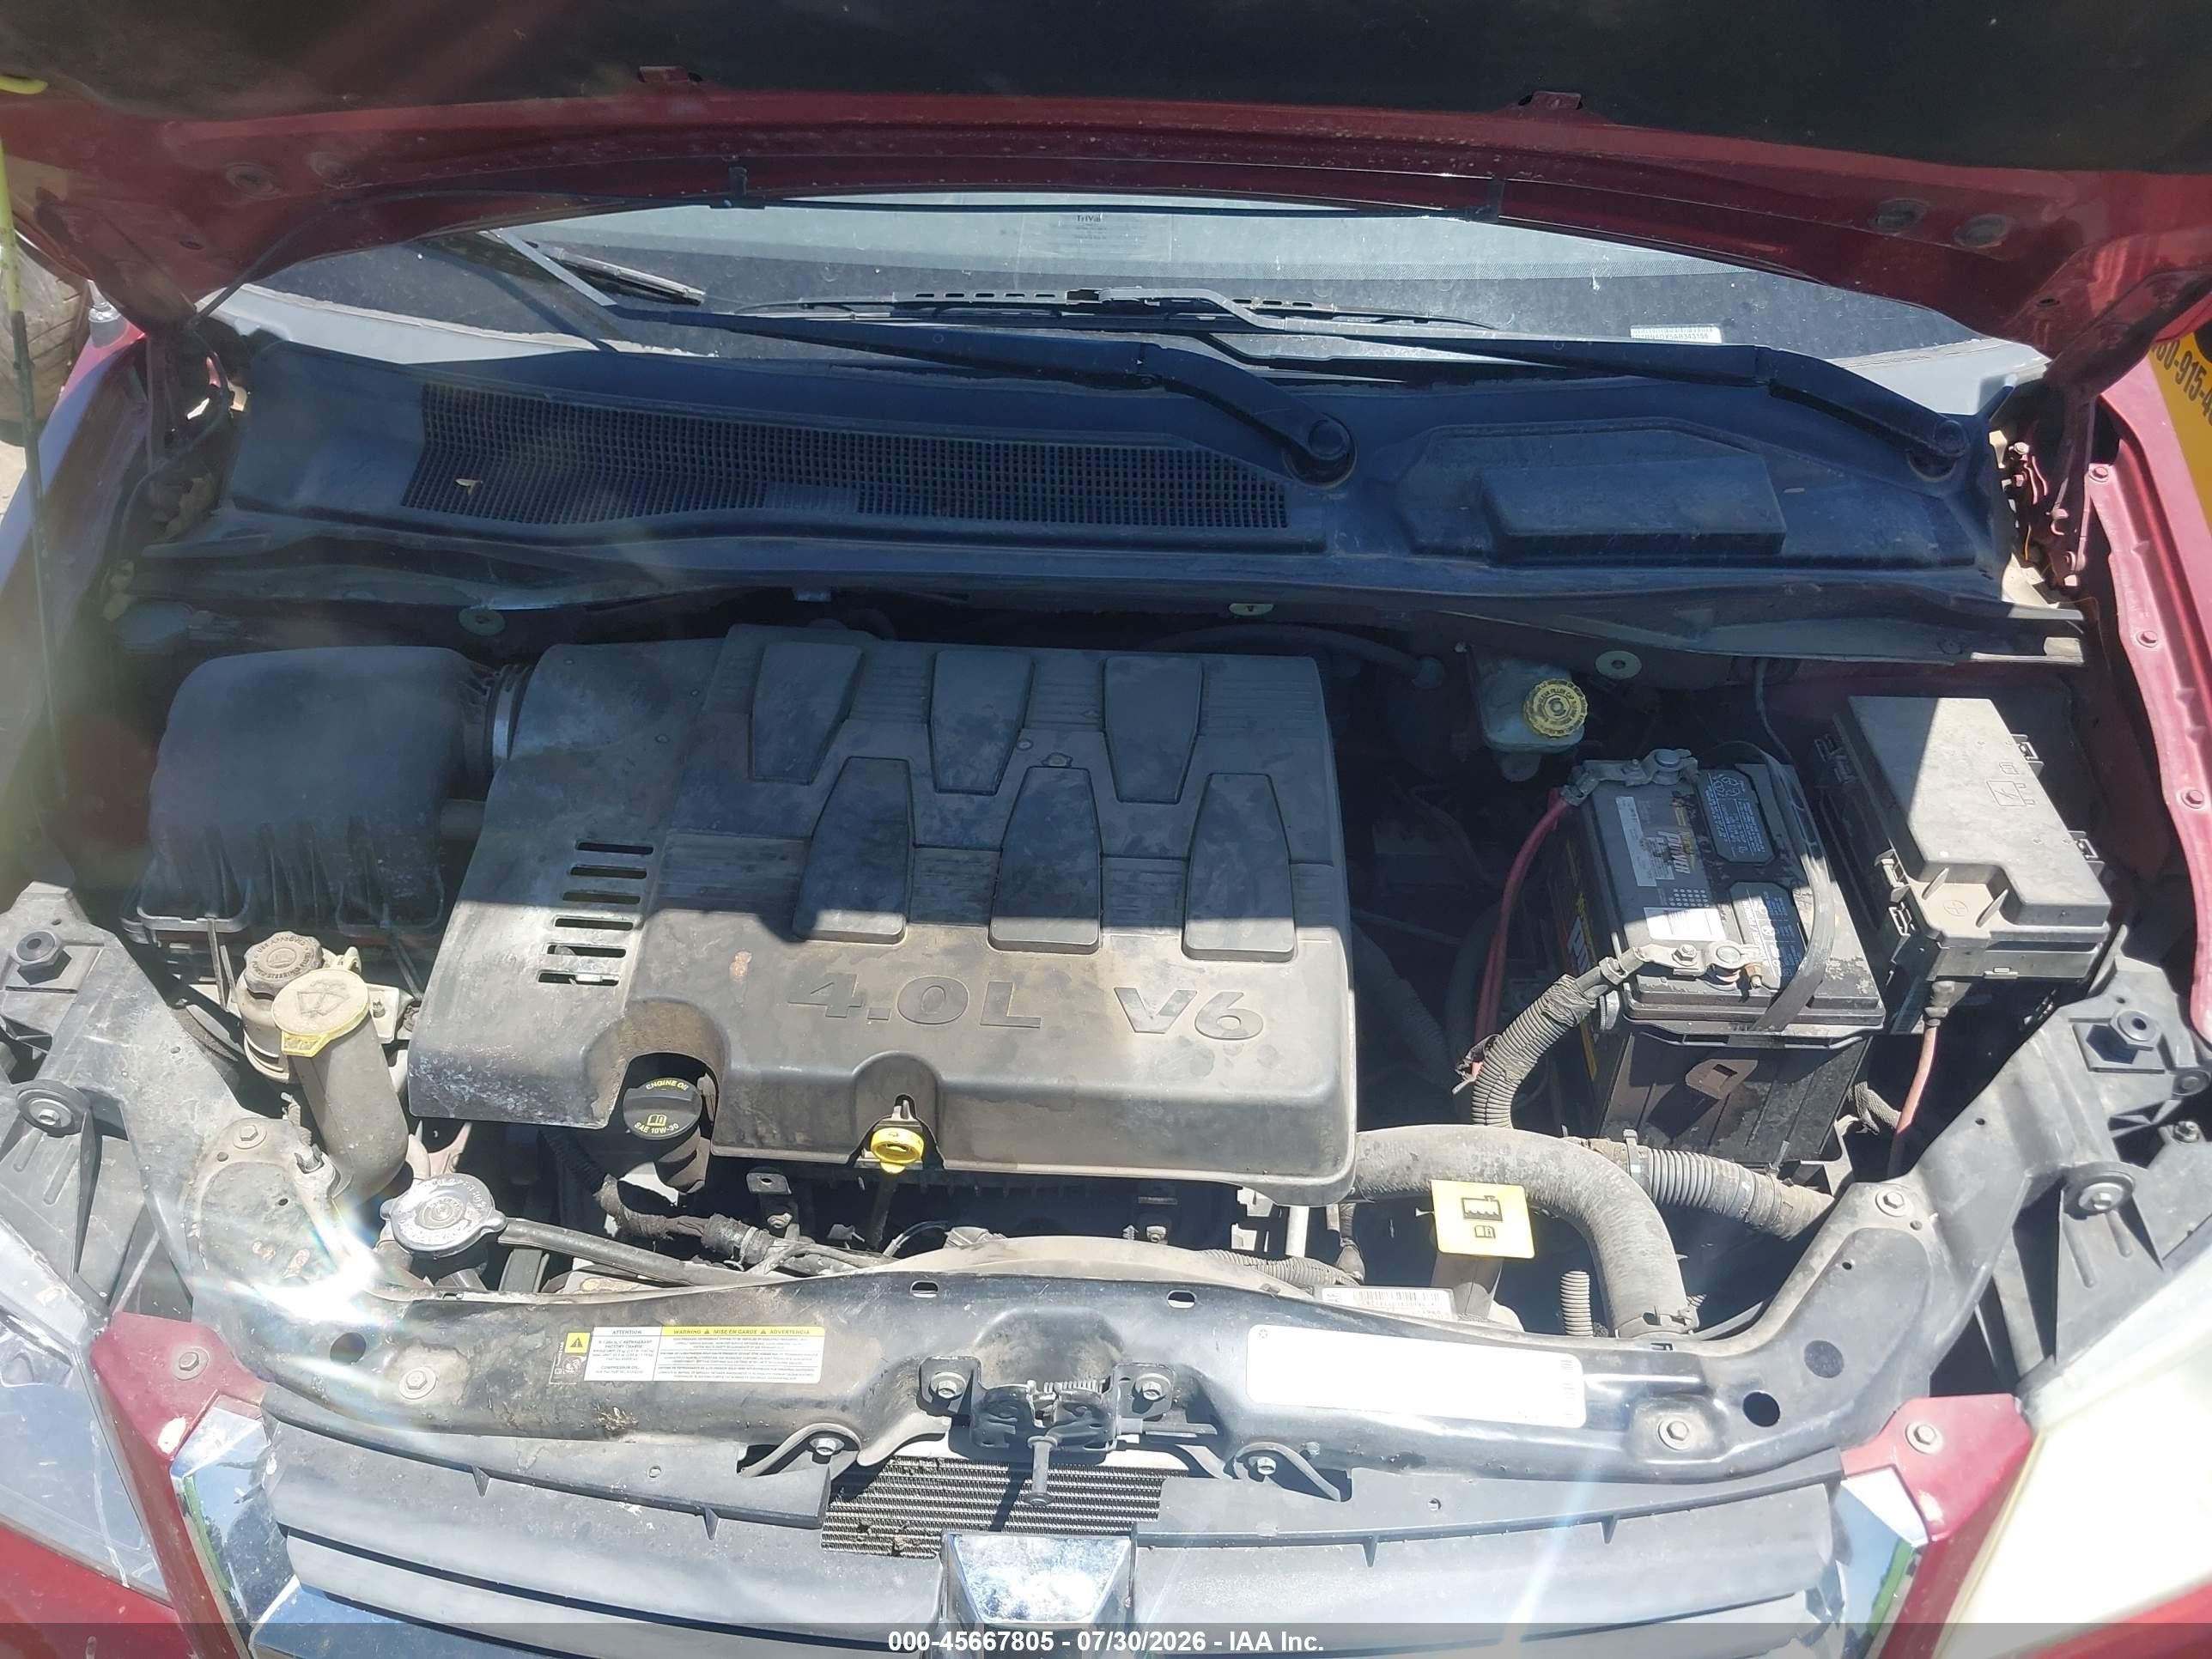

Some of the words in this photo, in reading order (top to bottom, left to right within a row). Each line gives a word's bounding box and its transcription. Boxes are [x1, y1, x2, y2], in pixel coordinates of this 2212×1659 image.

[787, 973, 1041, 1030] 4.0L
[1114, 987, 1264, 1041] V6
[646, 1079, 677, 1091] ENGINE
[677, 1081, 690, 1091] OIL
[634, 1121, 649, 1133] SAE
[651, 1122, 679, 1134] 10W-30
